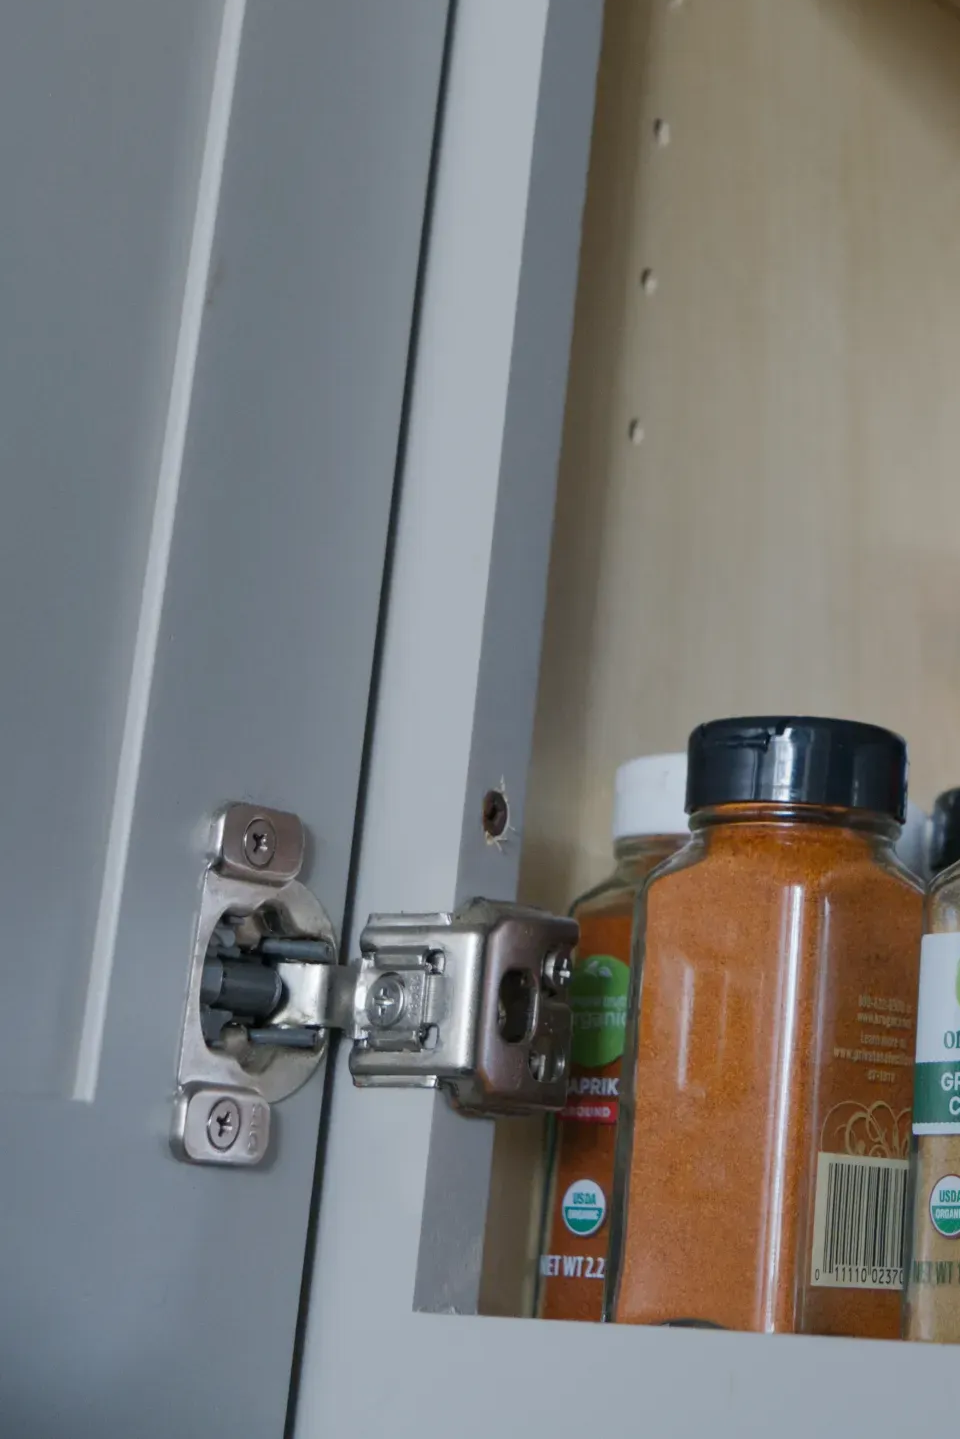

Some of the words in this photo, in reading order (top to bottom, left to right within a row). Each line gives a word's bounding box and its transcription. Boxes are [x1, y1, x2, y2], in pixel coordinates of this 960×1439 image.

[572, 1011, 627, 1031] rganic
[567, 1077, 620, 1096] APRIK
[572, 1192, 597, 1205] USDA
[540, 1254, 563, 1277] NET
[562, 1255, 585, 1278] WT
[814, 1267, 821, 1282] 0
[835, 1266, 868, 1284] 11110
[913, 1261, 936, 1285] NET
[936, 1261, 954, 1285] WT
